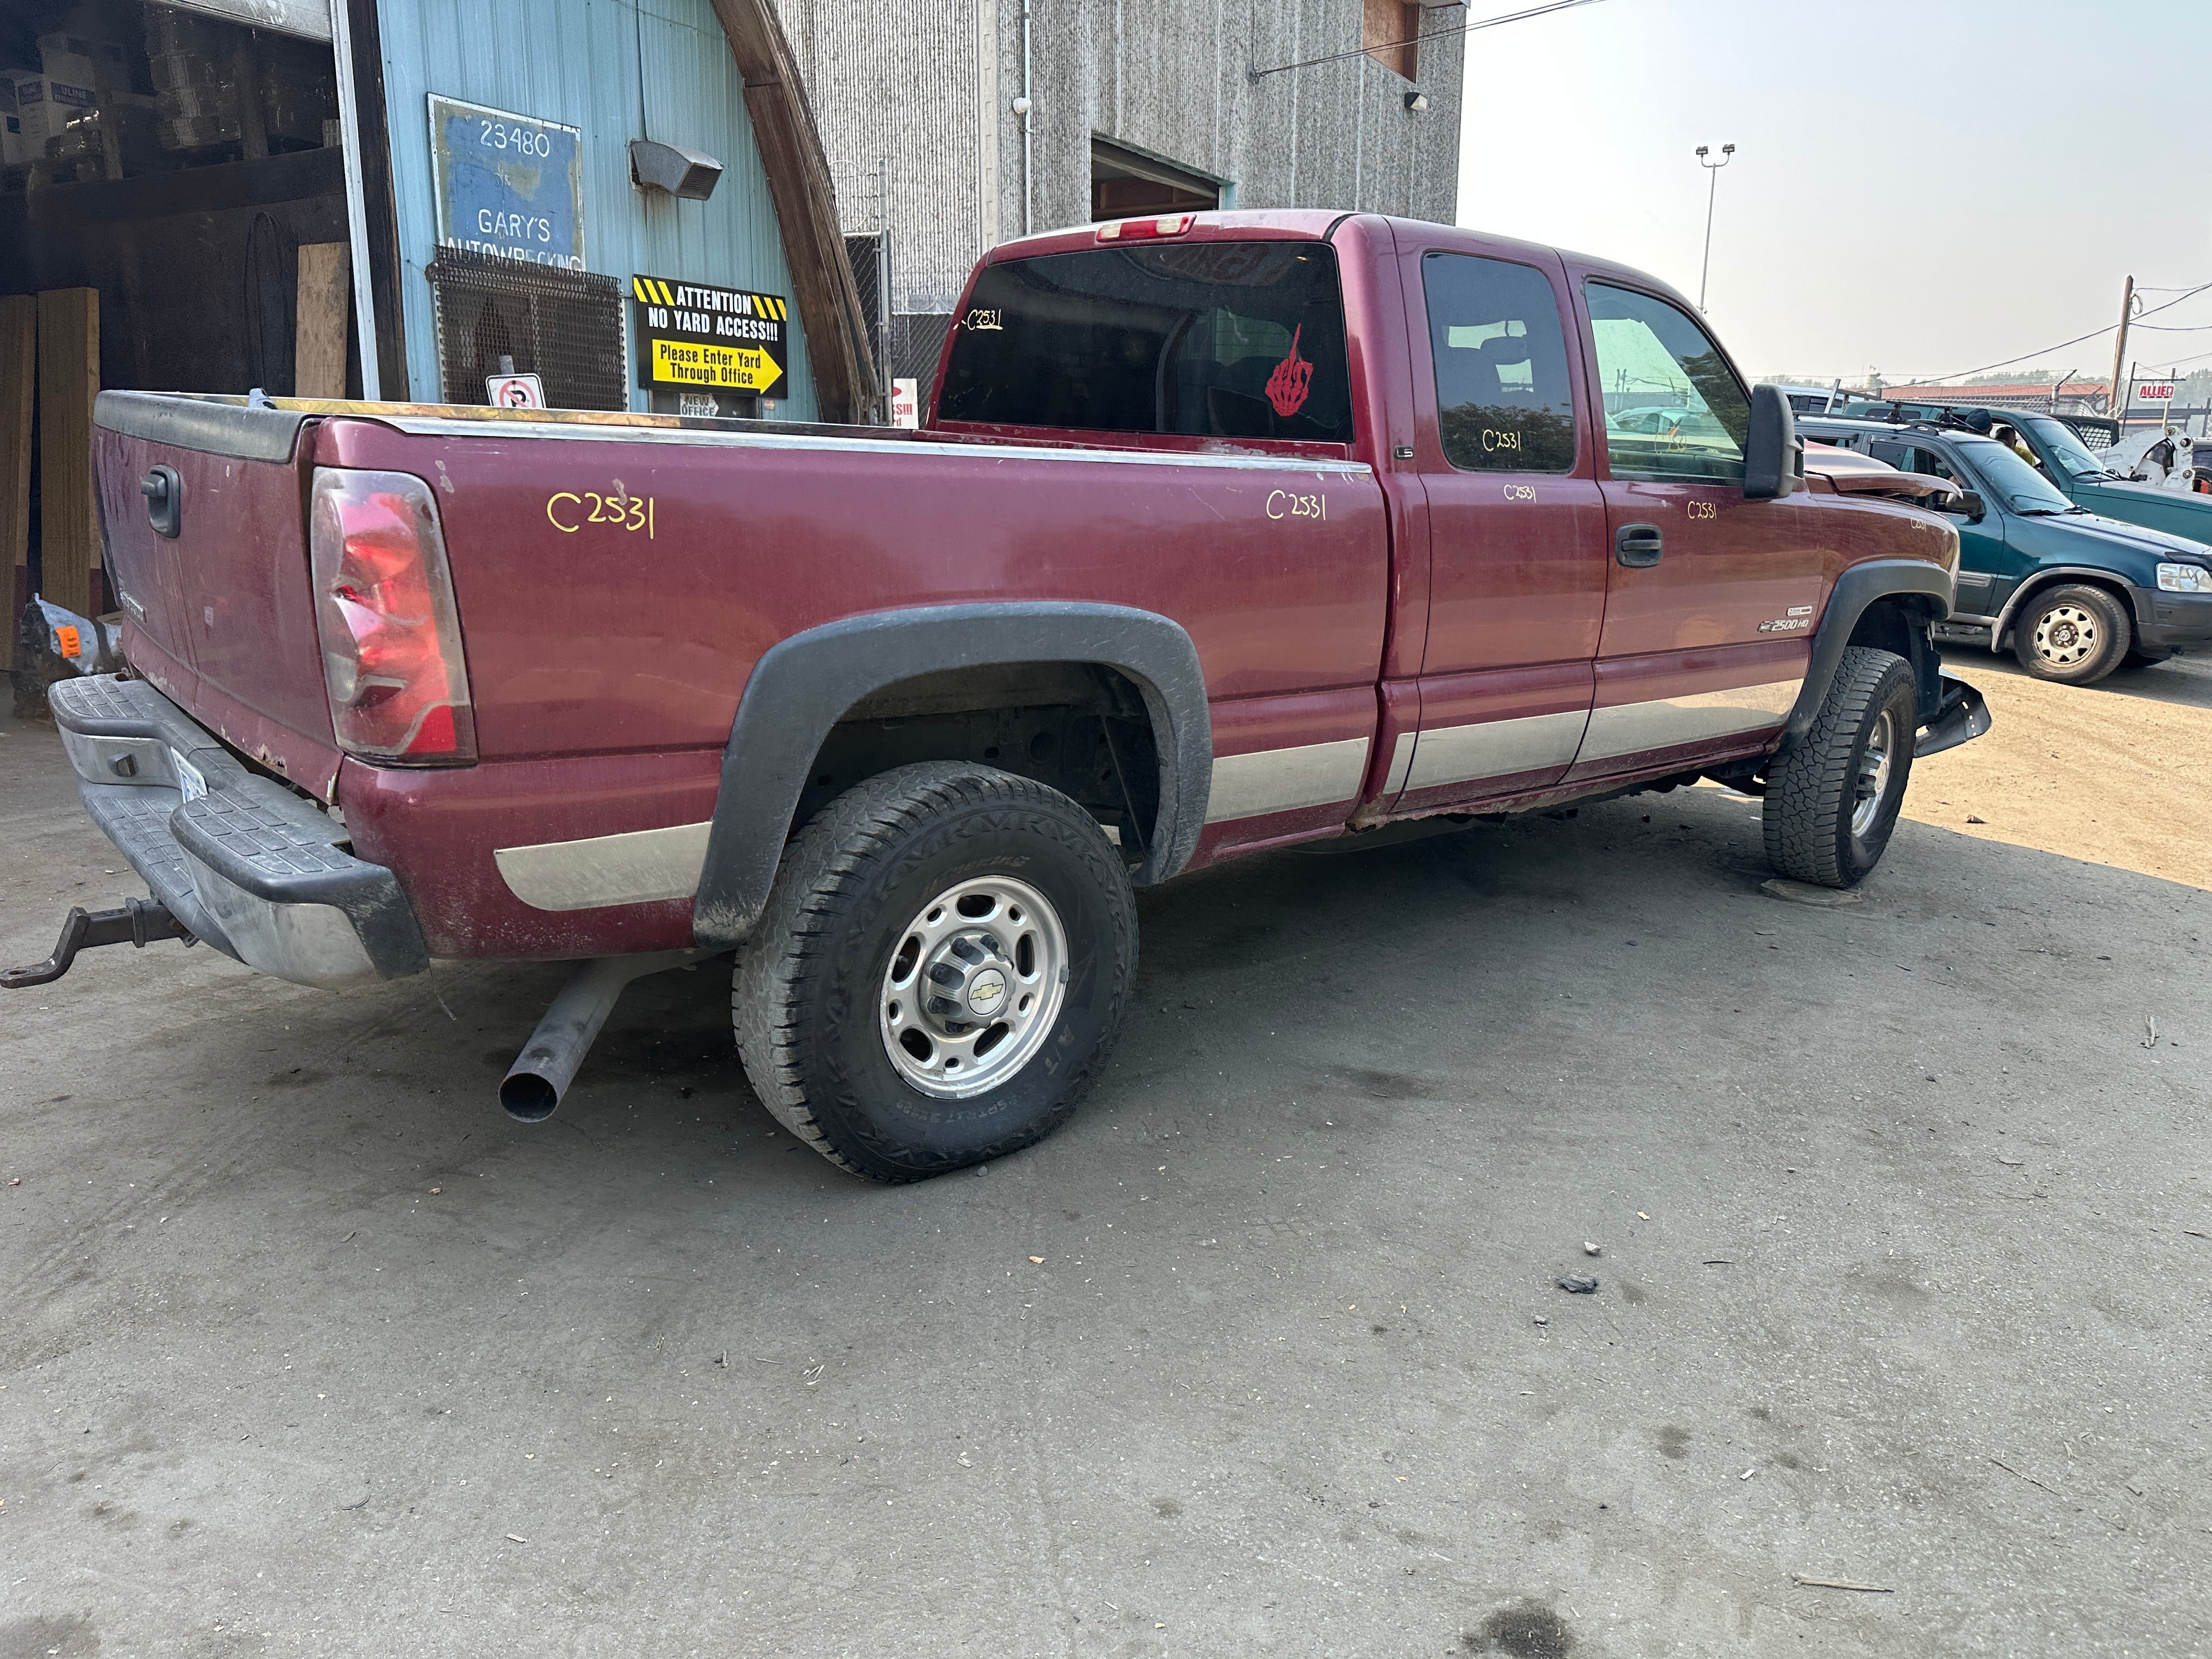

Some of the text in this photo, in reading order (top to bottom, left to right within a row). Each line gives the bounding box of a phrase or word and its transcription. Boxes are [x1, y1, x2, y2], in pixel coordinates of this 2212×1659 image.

[480, 120, 550, 157] 23480
[478, 209, 550, 243] GARY'S
[676, 286, 752, 315] ATTENTION
[648, 307, 778, 342] NO YARD ACCESS!!!
[967, 309, 1003, 330] C2531
[660, 344, 761, 369] Please Enter Yard
[670, 362, 753, 384] Through Office
[685, 395, 709, 406] NEW
[2139, 385, 2175, 396] ALLIED
[681, 404, 715, 416] OFFICE
[1483, 429, 1521, 452] C2531
[1503, 484, 1537, 503] C2531
[547, 493, 654, 539] C2531
[1266, 490, 1325, 521] C2531
[1688, 501, 1717, 519] C2531
[1771, 619, 1798, 631] 2500
